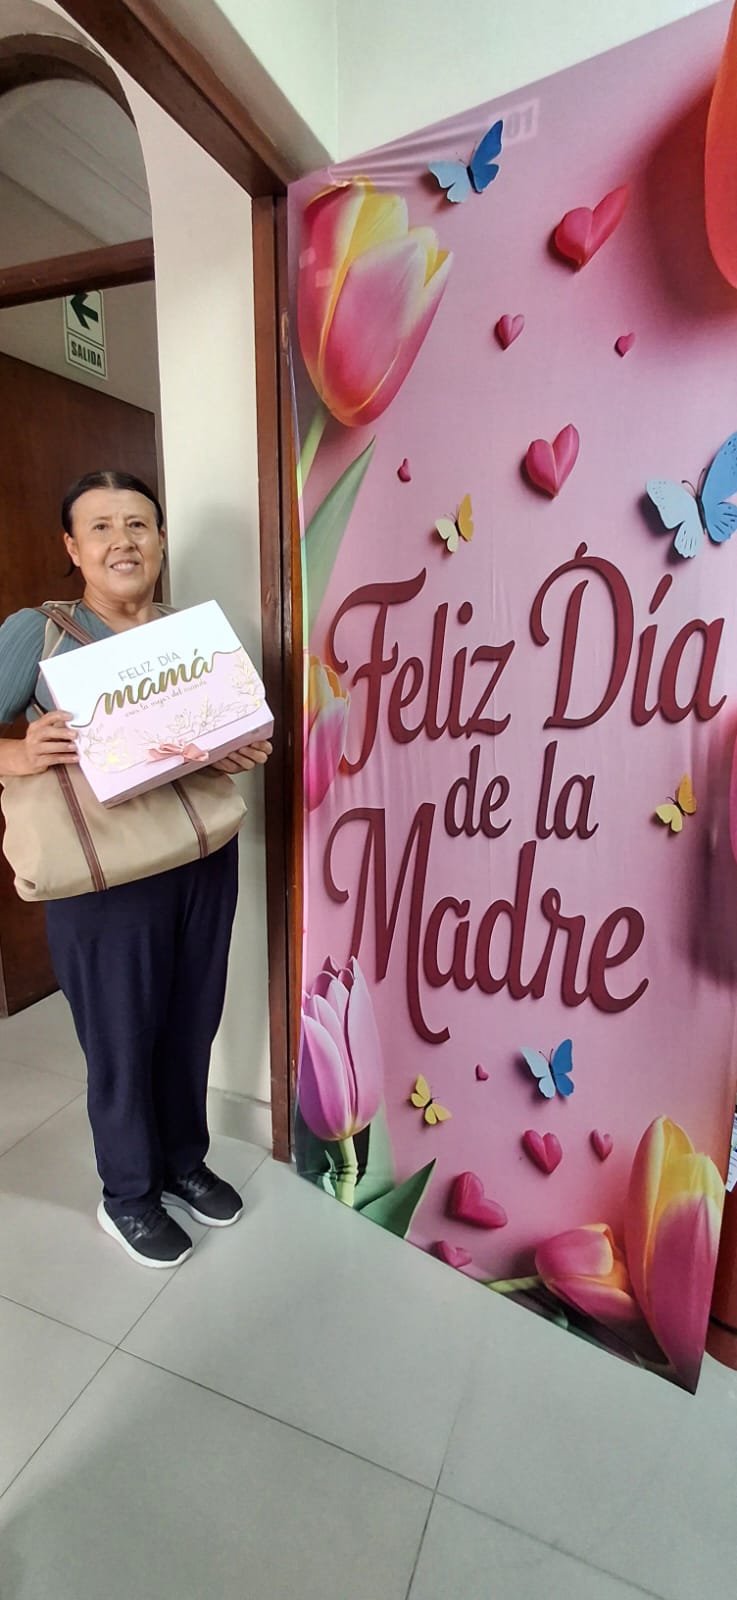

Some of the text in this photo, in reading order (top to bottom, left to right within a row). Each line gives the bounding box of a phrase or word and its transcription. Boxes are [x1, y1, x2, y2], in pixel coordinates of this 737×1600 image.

[71, 341, 102, 368] SALIDA
[103, 648, 213, 715] mamá
[118, 650, 182, 681] FELIZ DÍA
[328, 542, 727, 774] Feliz Día
[139, 702, 149, 711] la
[171, 687, 183, 698] del
[444, 740, 599, 839] de la
[323, 801, 650, 1045] Madre
